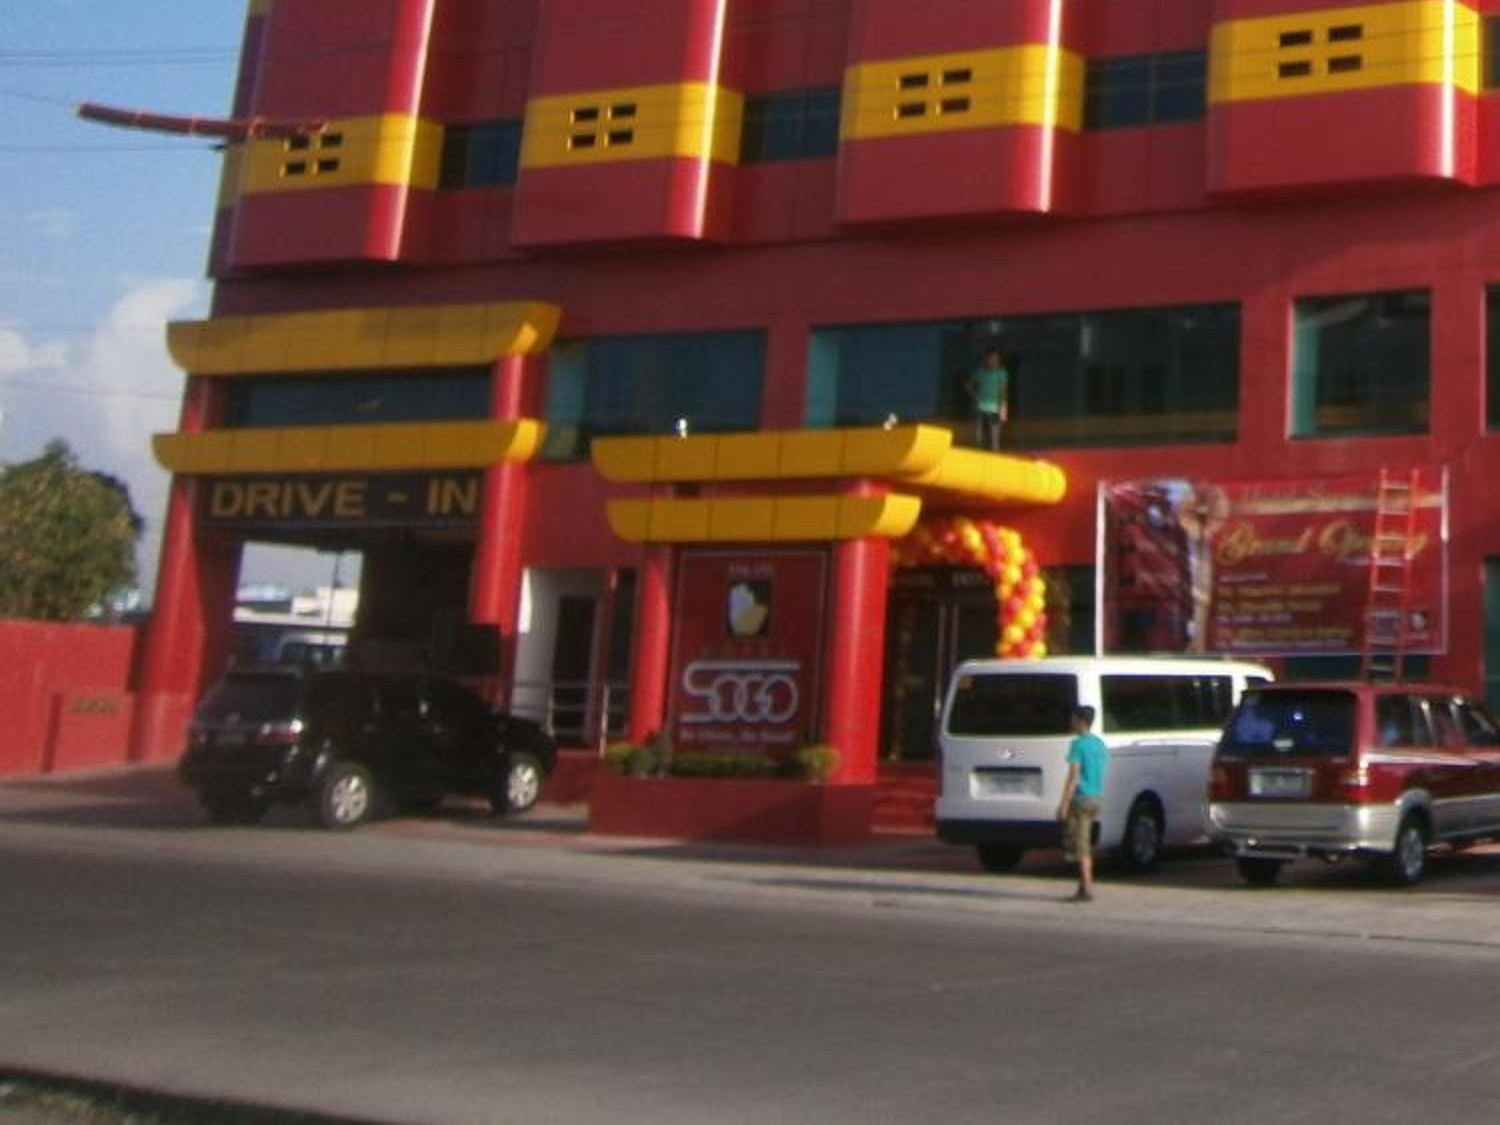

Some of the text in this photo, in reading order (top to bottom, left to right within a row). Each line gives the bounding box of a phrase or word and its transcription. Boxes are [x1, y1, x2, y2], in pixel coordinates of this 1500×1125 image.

[211, 480, 368, 518] DRIVE
[427, 477, 479, 515] IN
[680, 660, 801, 723] SOGO
